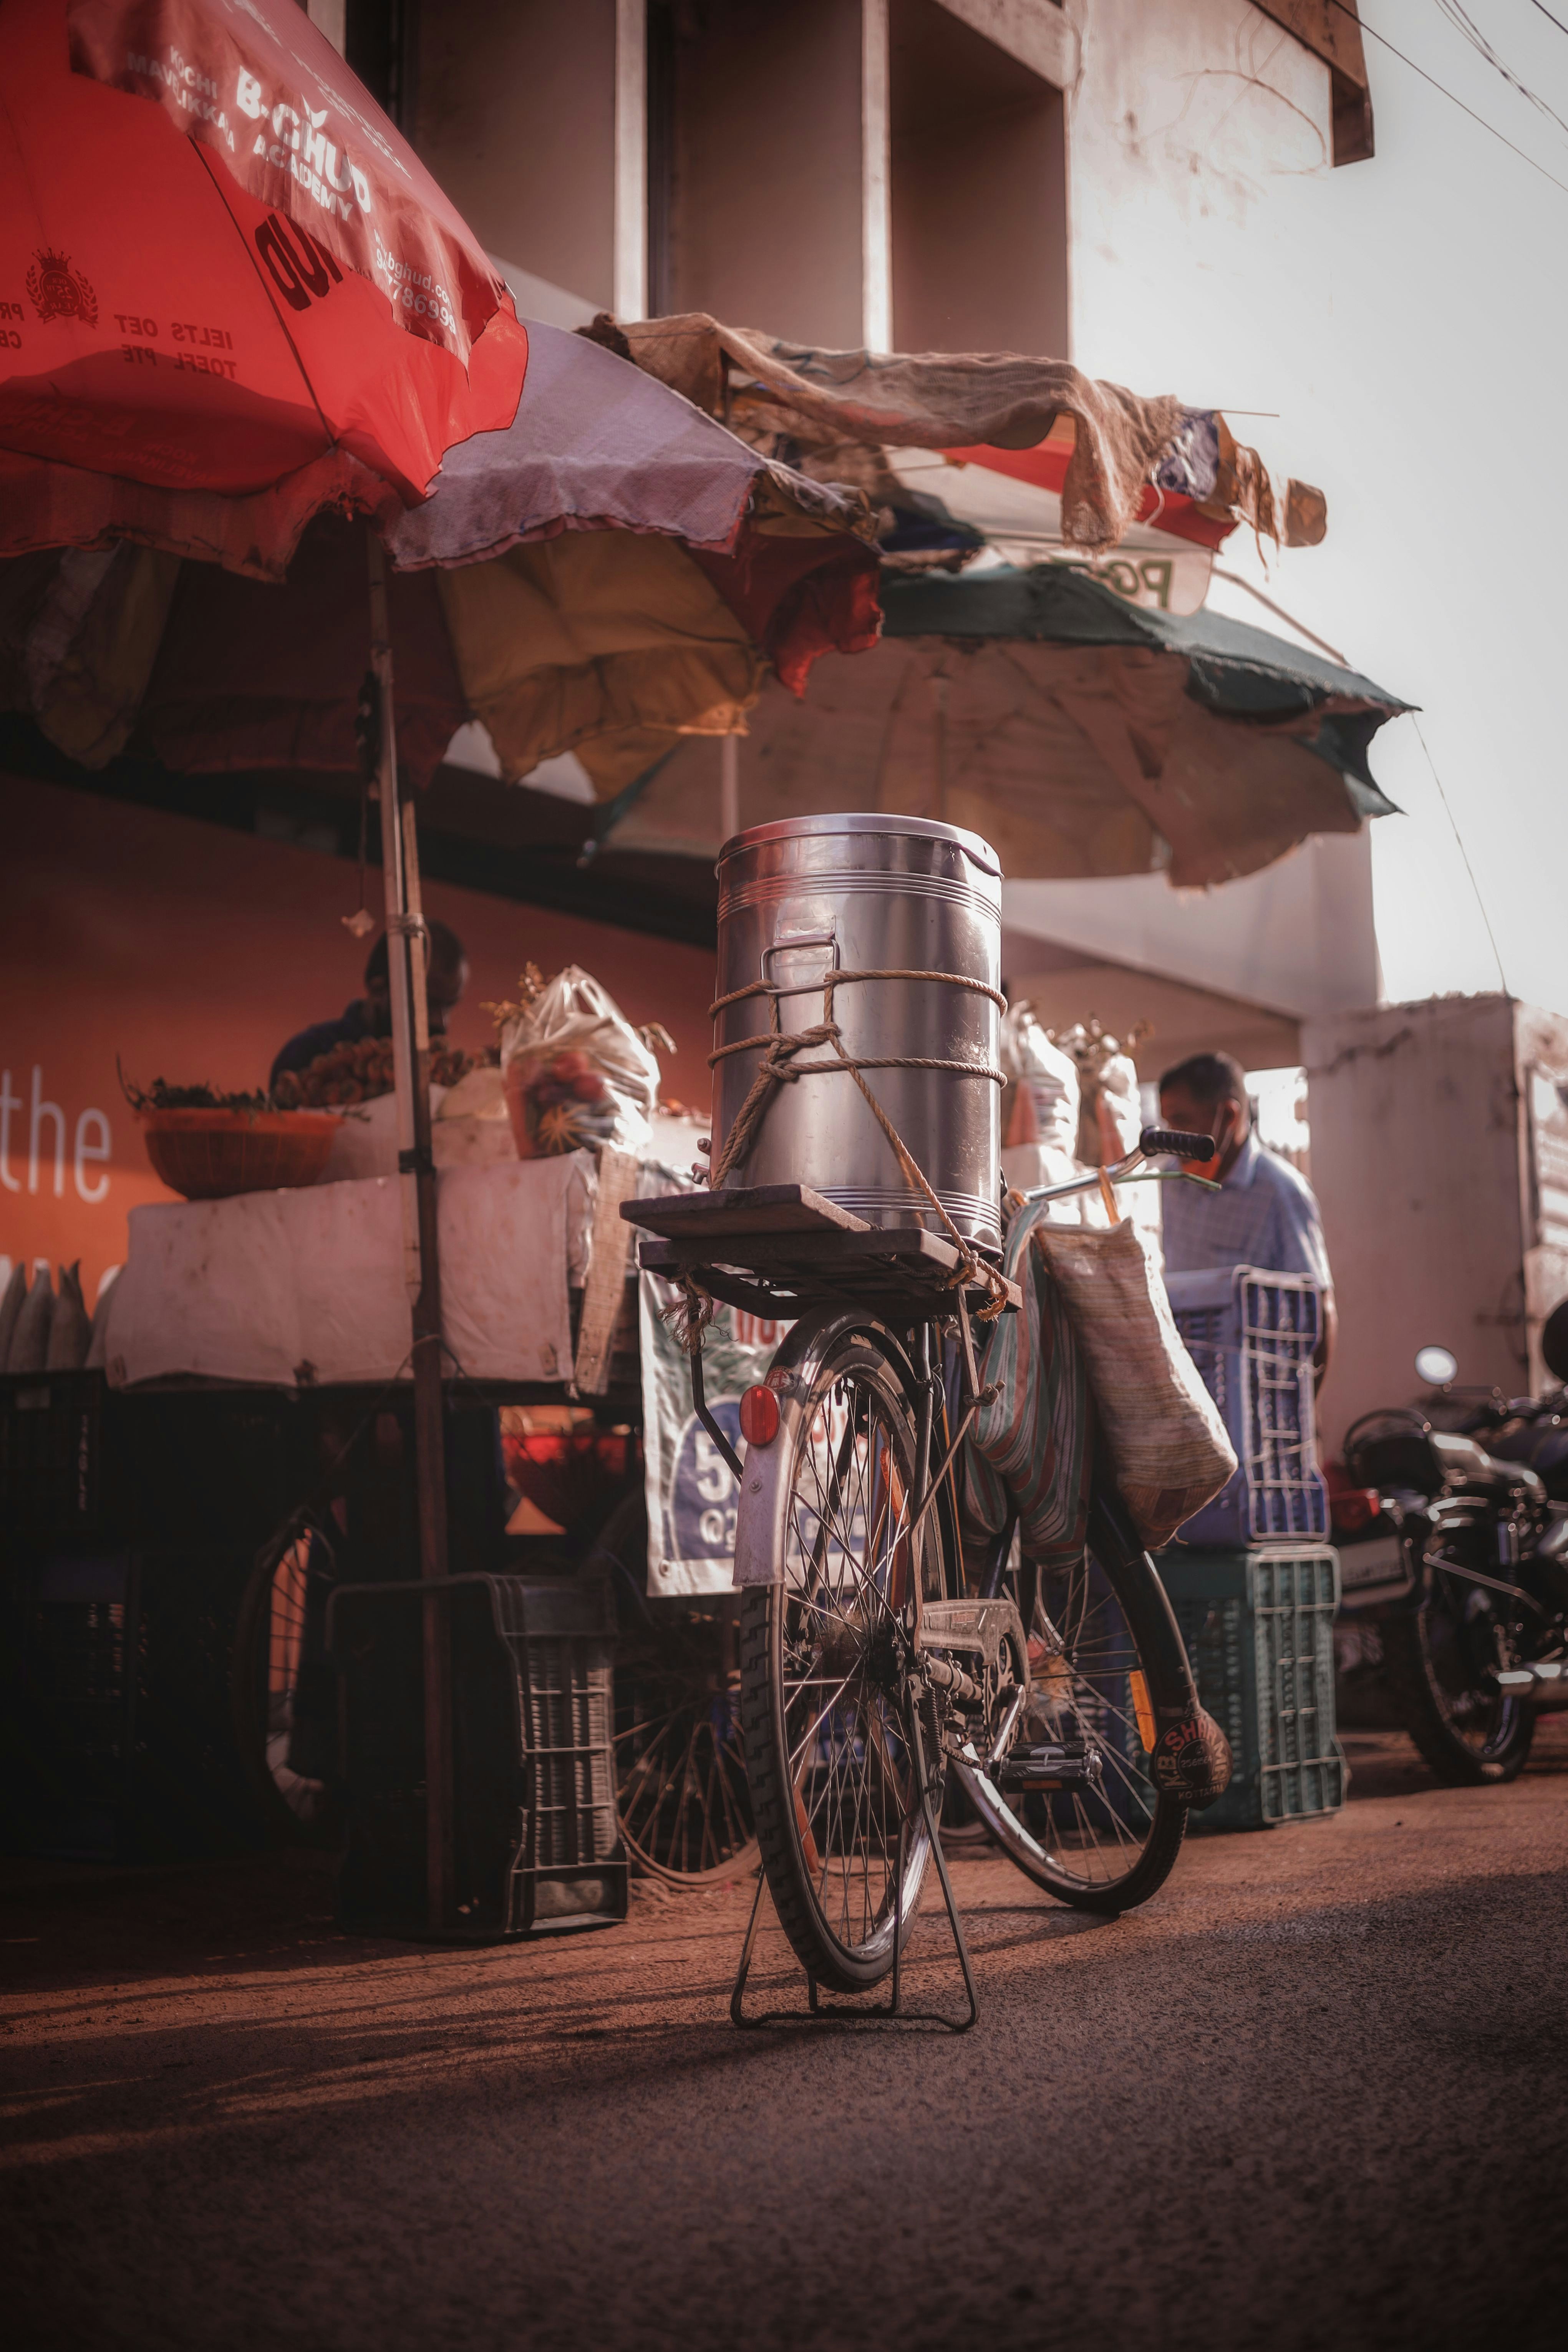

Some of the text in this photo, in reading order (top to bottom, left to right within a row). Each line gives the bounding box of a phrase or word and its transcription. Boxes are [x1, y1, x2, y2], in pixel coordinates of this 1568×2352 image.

[171, 45, 217, 100] KOCHI
[253, 134, 353, 222] ACADEMY
[0, 1064, 111, 1203] the
[922, 1856, 931, 1882] MADE
[912, 1894, 921, 1916] INDIA
